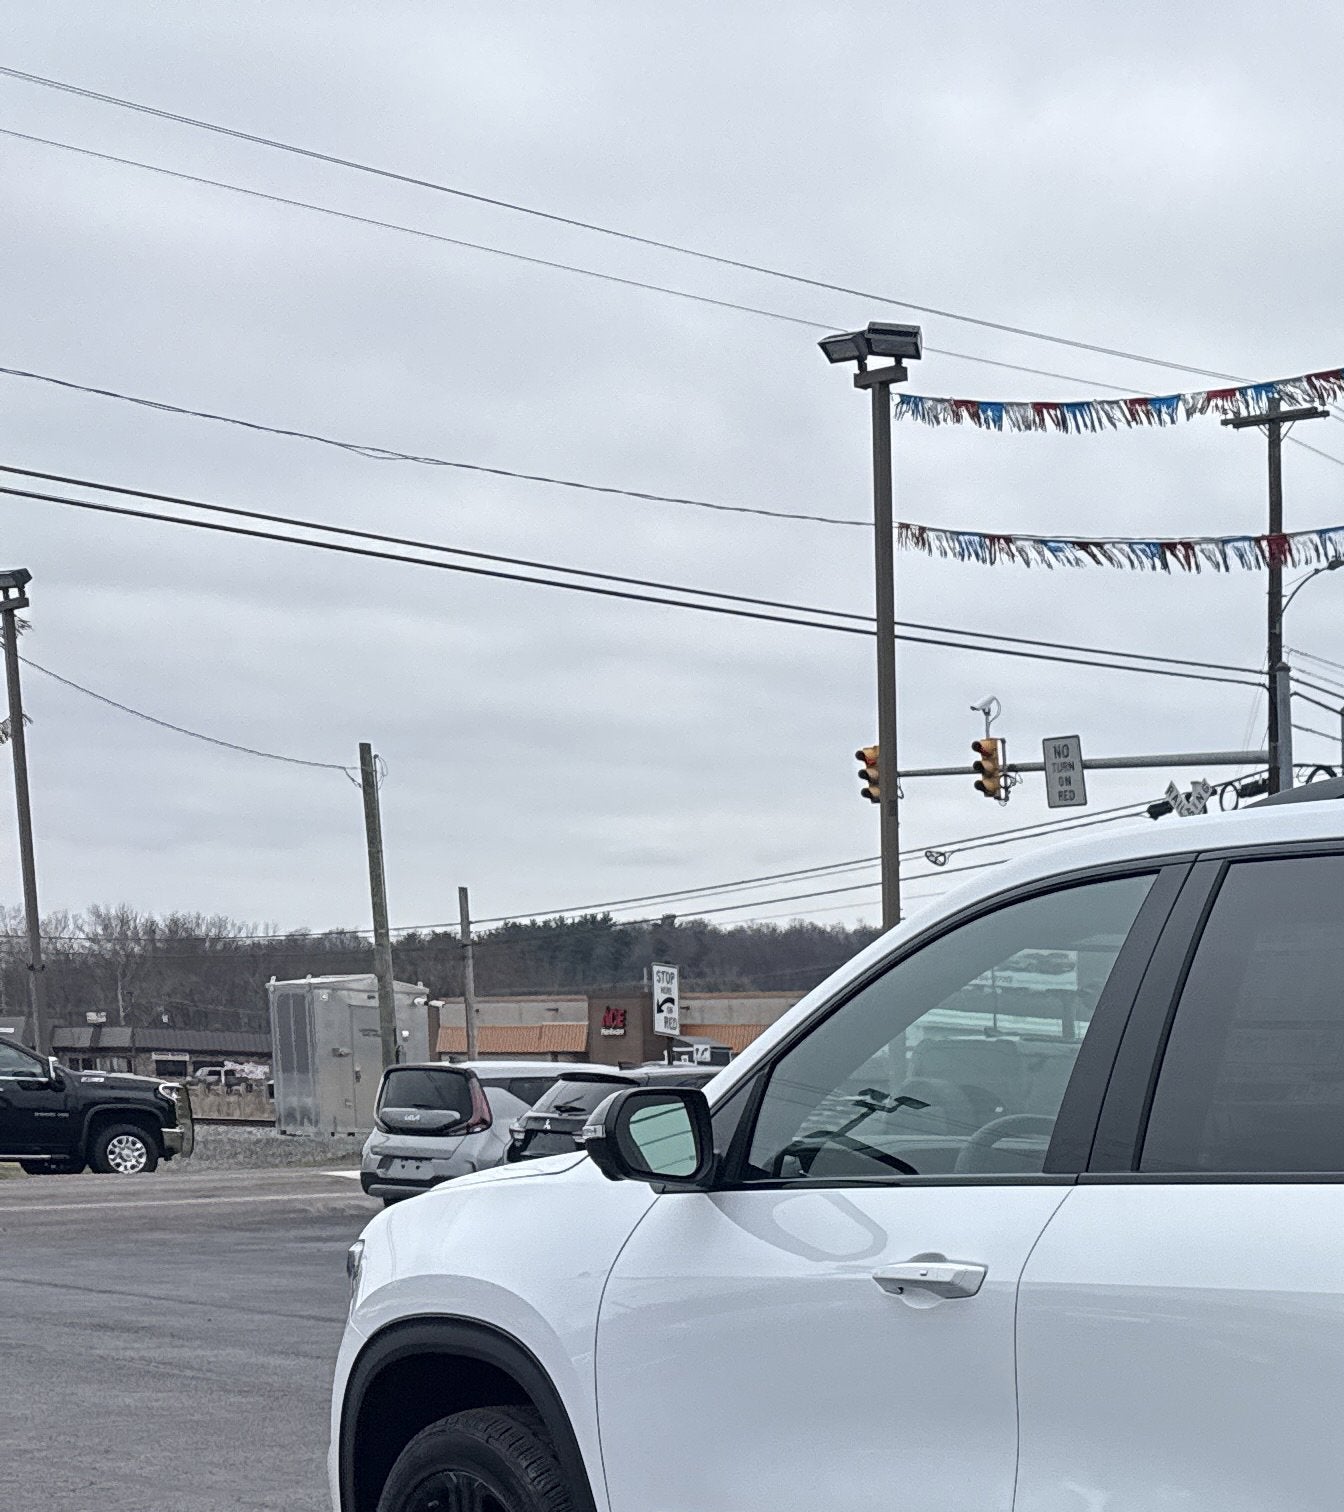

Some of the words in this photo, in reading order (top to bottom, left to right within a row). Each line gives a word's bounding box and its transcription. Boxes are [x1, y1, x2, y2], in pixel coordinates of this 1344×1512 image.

[1053, 743, 1070, 759] NO
[1052, 760, 1075, 774] TURN
[1058, 775, 1072, 787] ON
[1057, 789, 1076, 802] RED
[656, 970, 675, 984] STOP
[602, 1007, 625, 1027] ACE
[664, 1016, 677, 1030] RED
